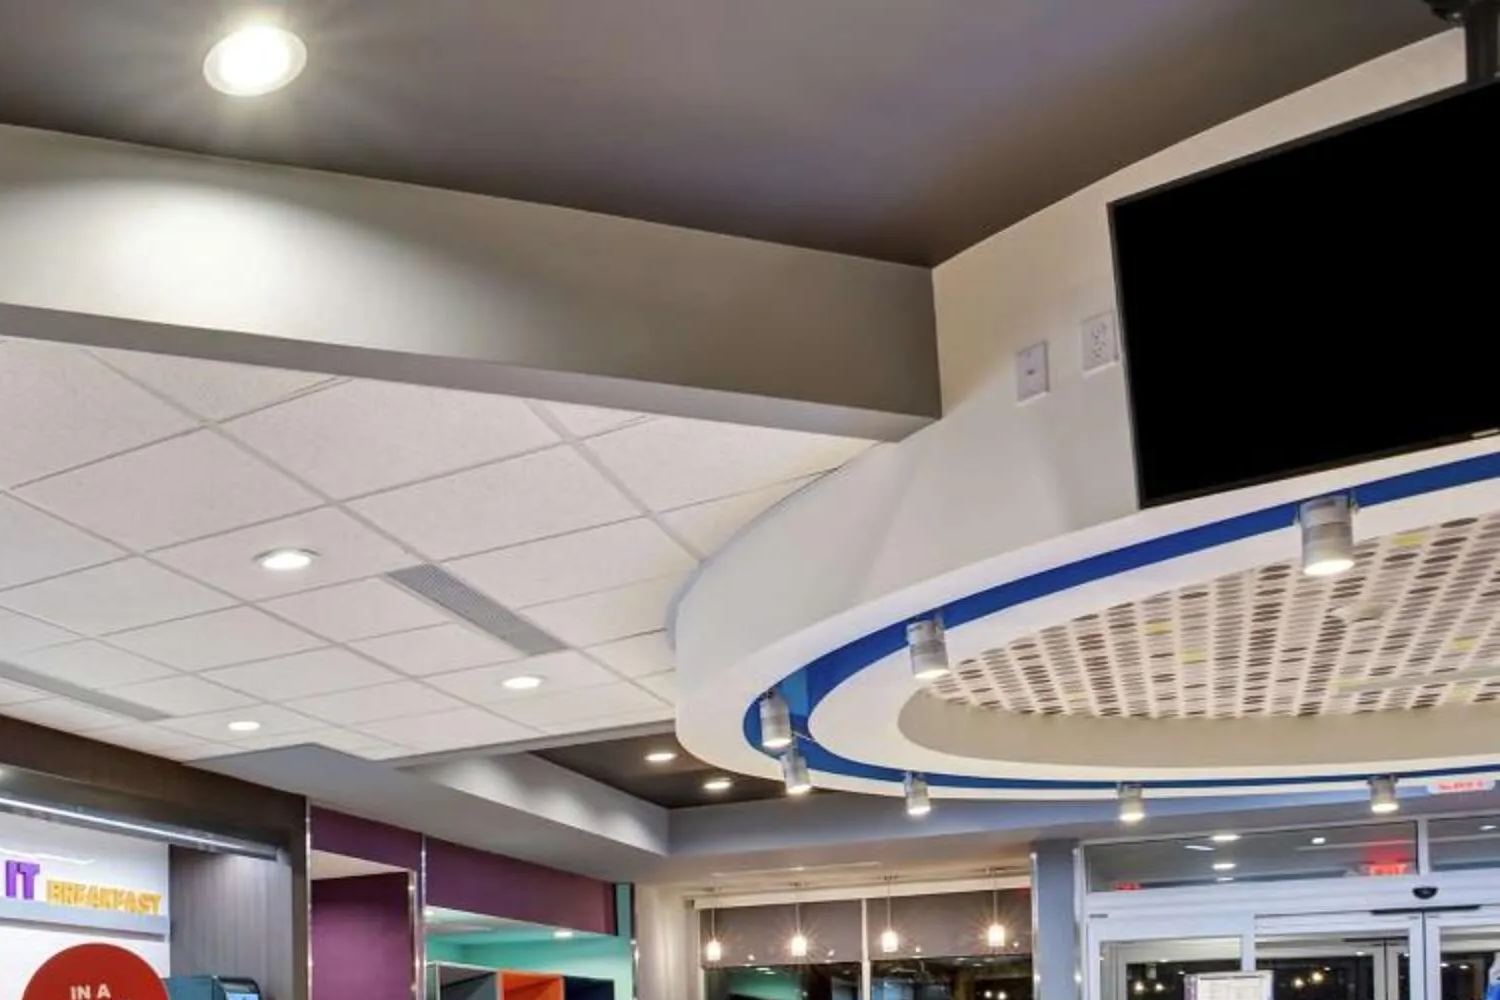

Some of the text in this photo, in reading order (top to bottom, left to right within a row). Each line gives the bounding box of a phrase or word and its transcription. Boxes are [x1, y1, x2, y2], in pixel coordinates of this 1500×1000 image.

[5, 860, 40, 900] IT
[47, 880, 162, 916] BREAKFAST
[70, 984, 111, 1000] IN A
